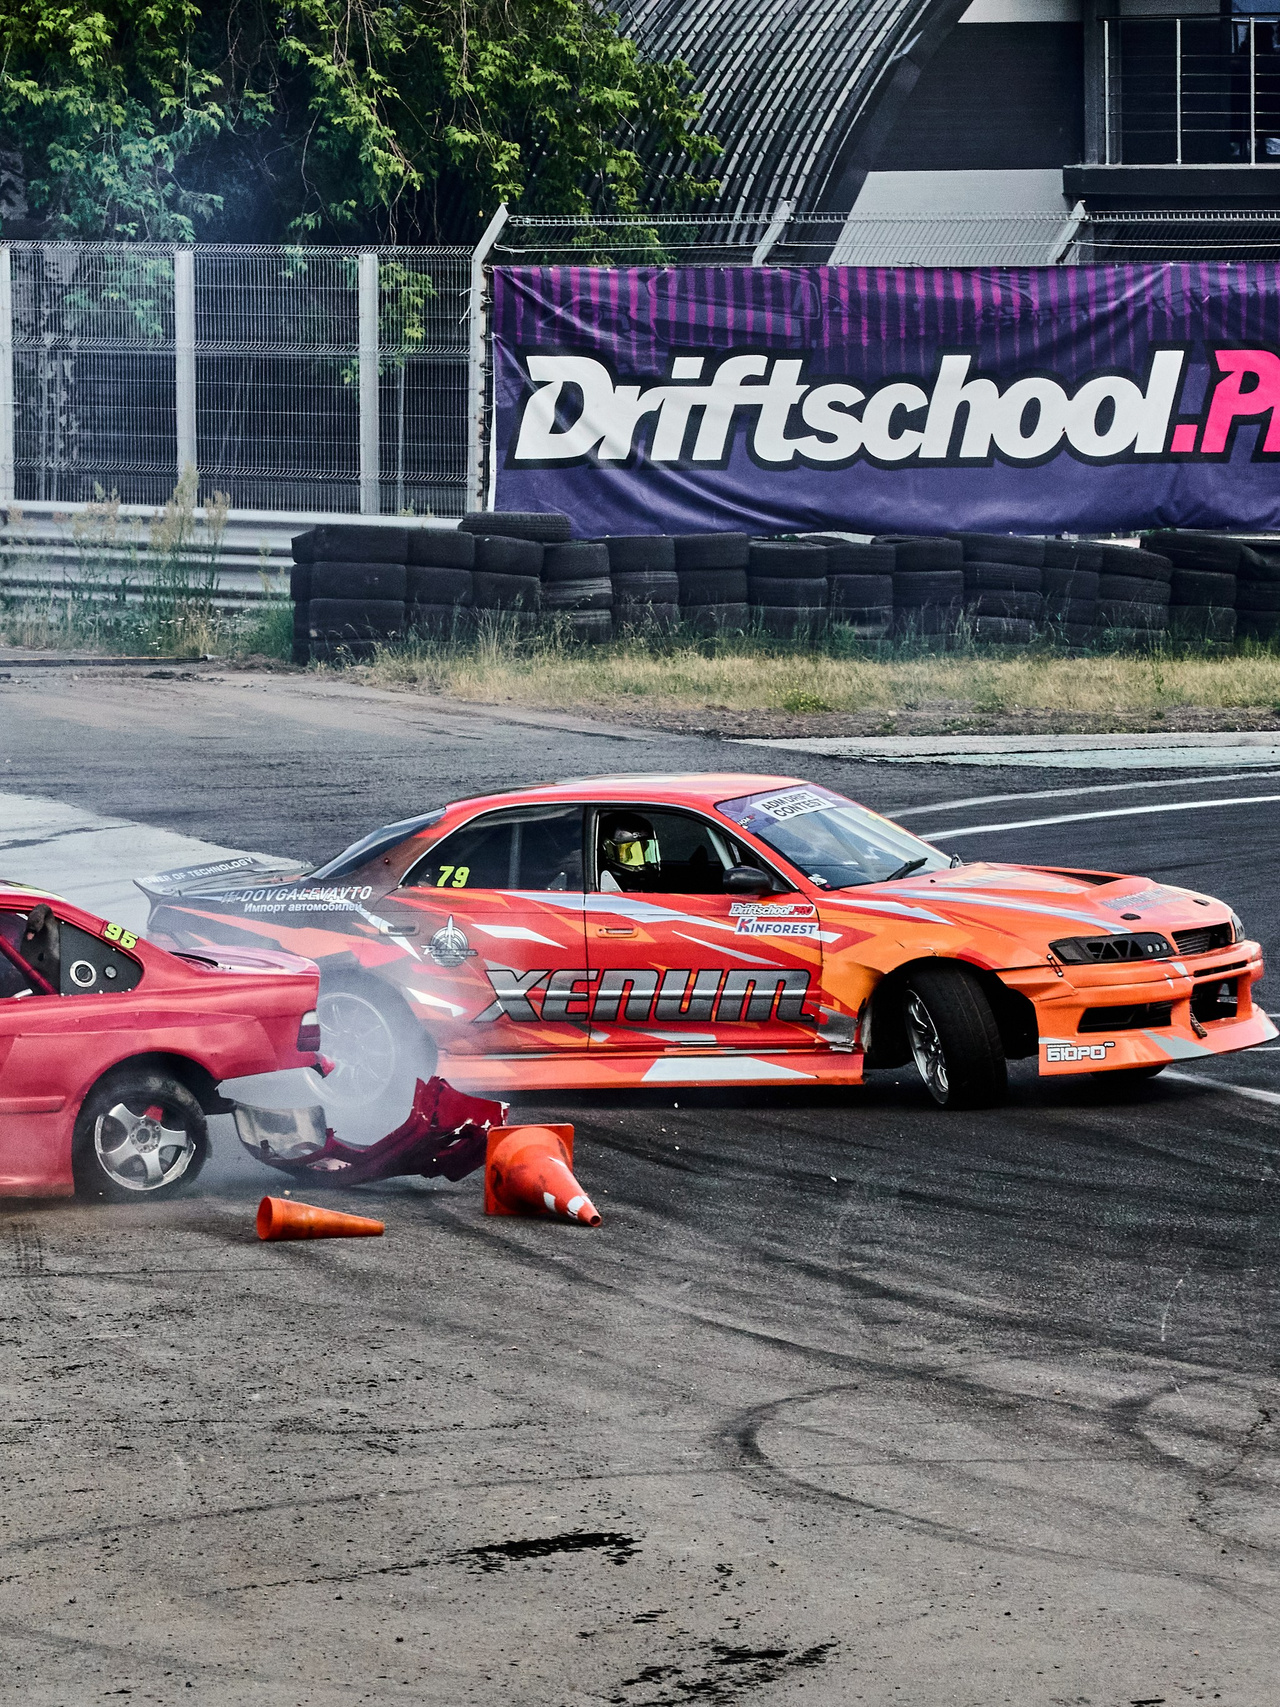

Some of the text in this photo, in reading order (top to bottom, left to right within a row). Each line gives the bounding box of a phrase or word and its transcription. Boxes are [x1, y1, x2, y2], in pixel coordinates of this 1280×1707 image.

[514, 349, 1280, 461] Driftschool.P
[761, 792, 812, 810] ADM DRIFT
[773, 799, 826, 817] CONTEST
[135, 857, 254, 883] POWER OF TECHNOLOGY
[436, 865, 470, 888] 79
[244, 901, 363, 914] Импорт автомобилей
[104, 923, 139, 949] 95
[738, 918, 816, 935] KINFOREST
[472, 968, 815, 1022] XENUM
[1047, 1045, 1106, 1062] БЮРО
